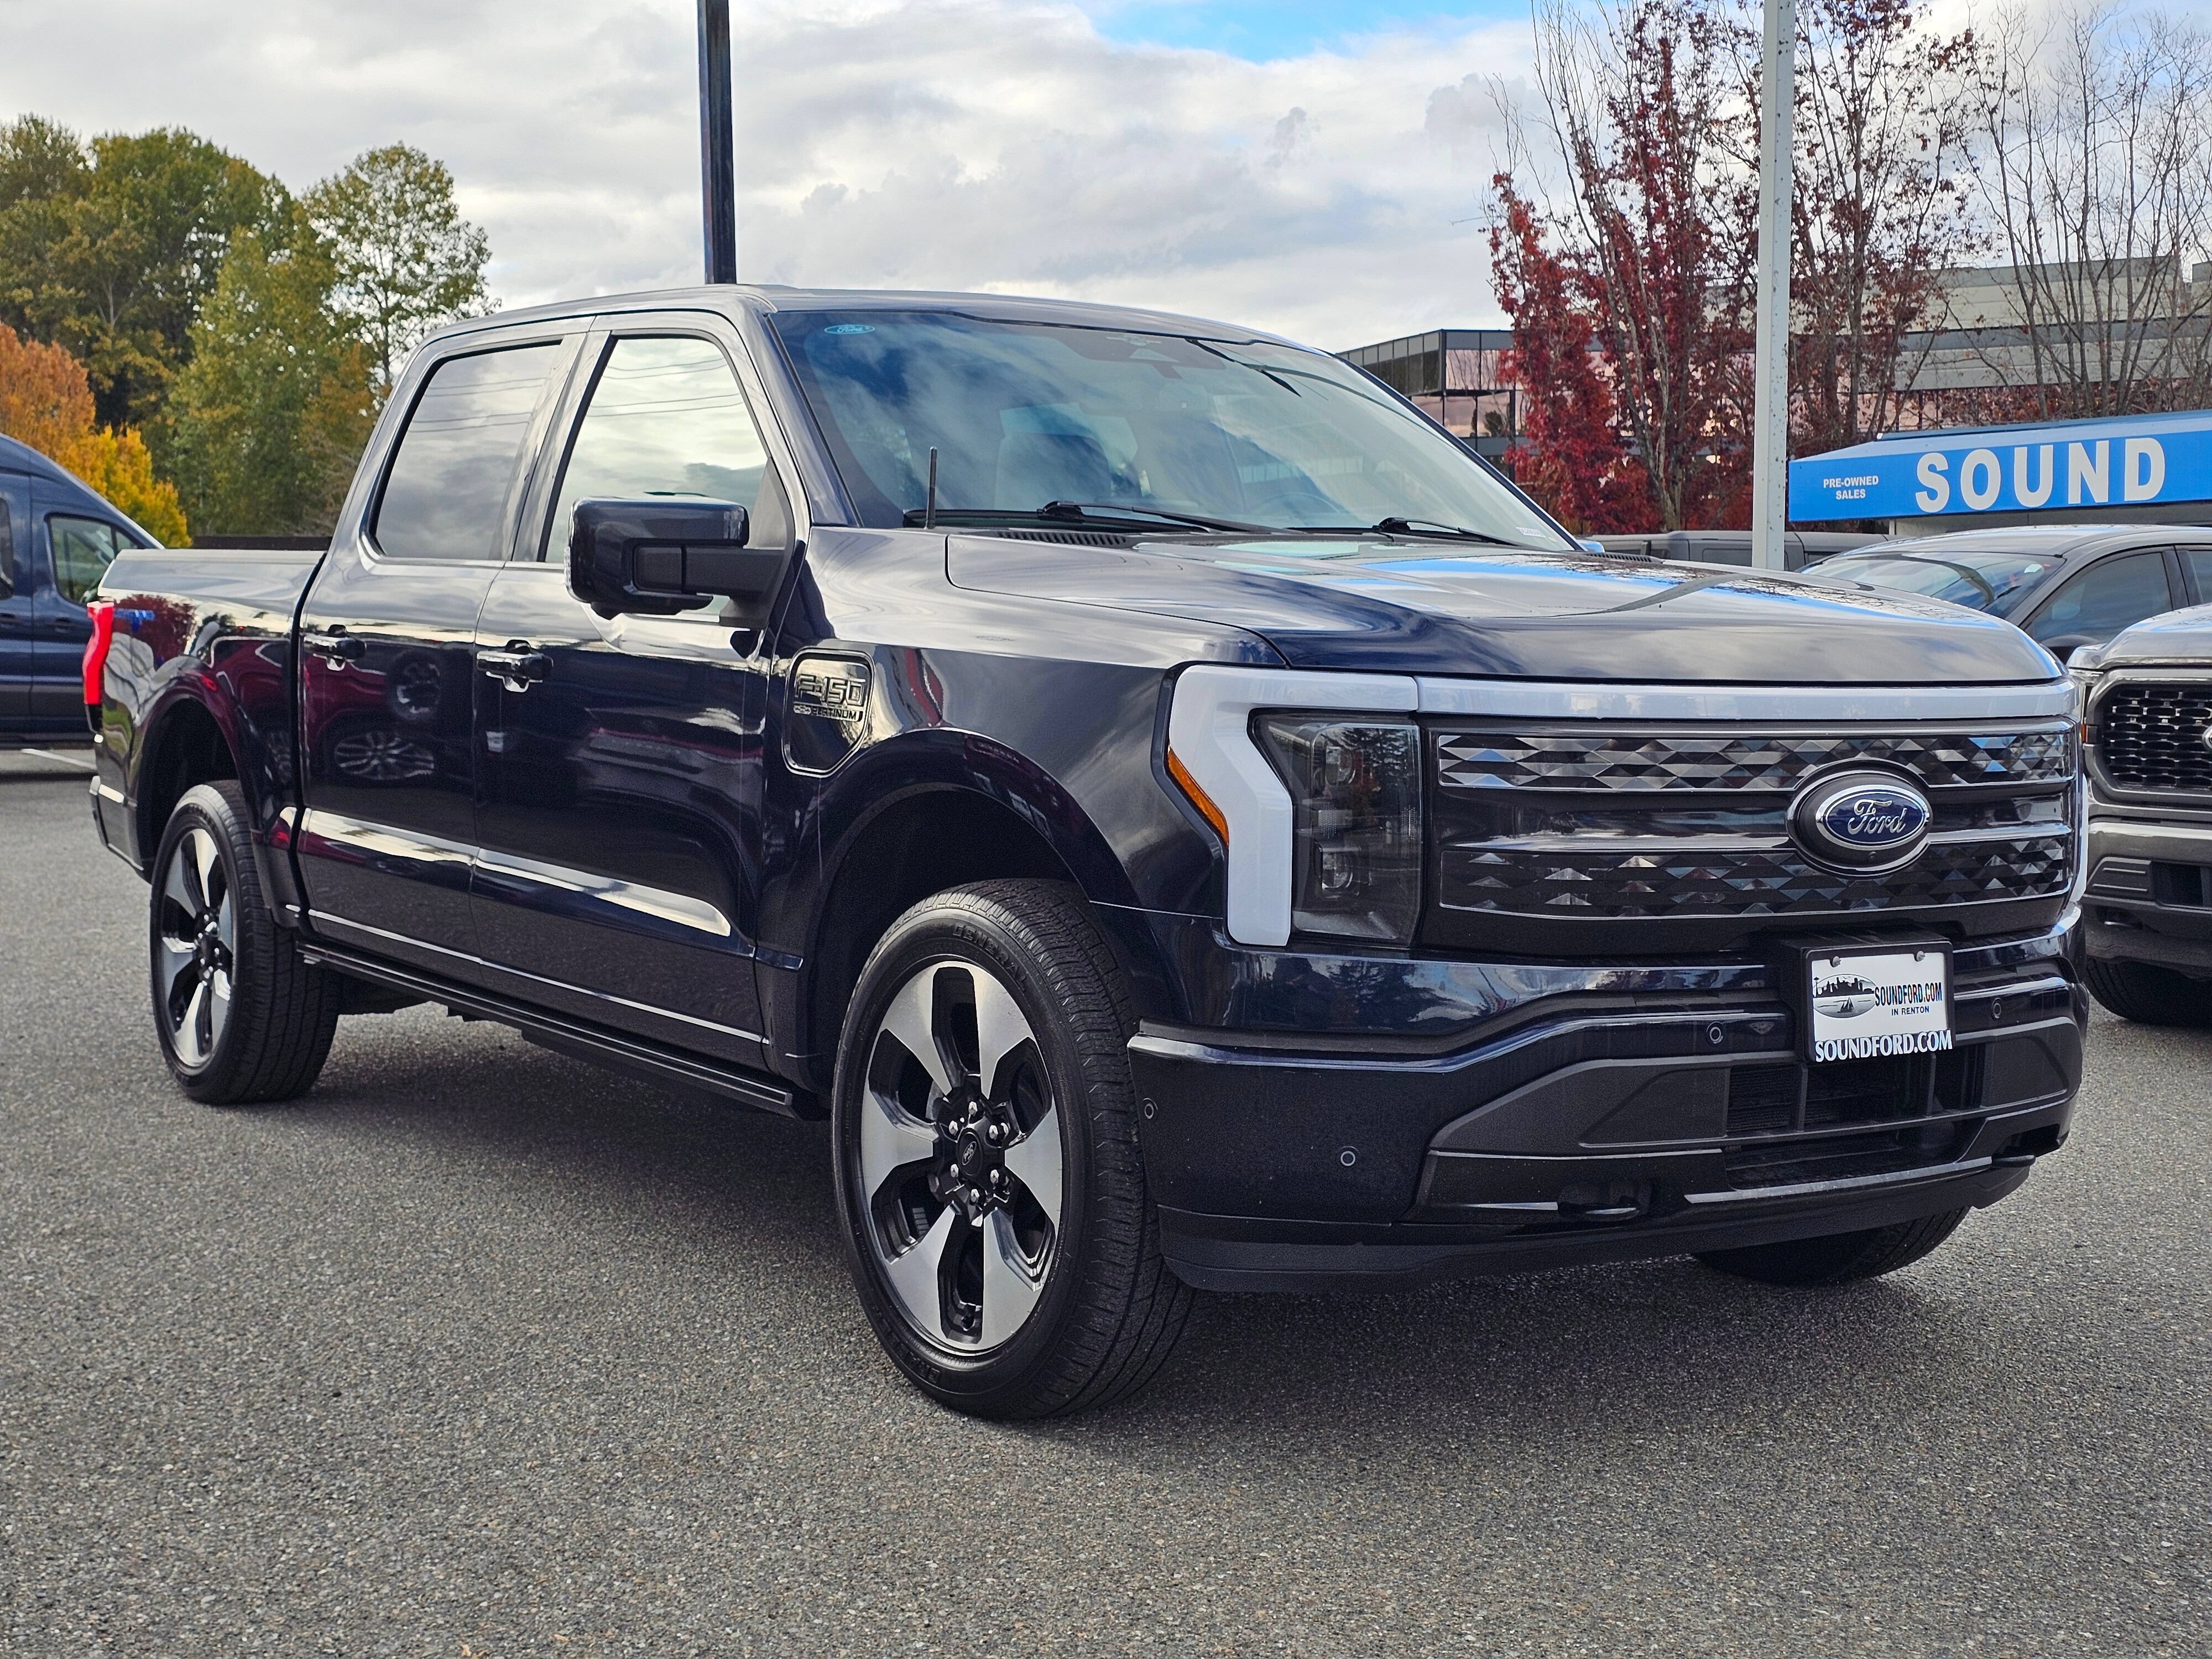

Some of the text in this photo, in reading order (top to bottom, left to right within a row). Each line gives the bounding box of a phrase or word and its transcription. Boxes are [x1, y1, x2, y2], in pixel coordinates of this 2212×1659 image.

[1823, 476, 1879, 488] PRE-OWNED
[1915, 438, 2165, 513] SOUND
[1836, 489, 1866, 500] SALES
[795, 674, 865, 707] F-150
[1848, 799, 1908, 834] Ford
[1875, 982, 1942, 1006] SOUNDFORD.COM
[1901, 1005, 1929, 1015] RENTON
[1815, 1029, 1953, 1062] SOUNDFORD.COM
